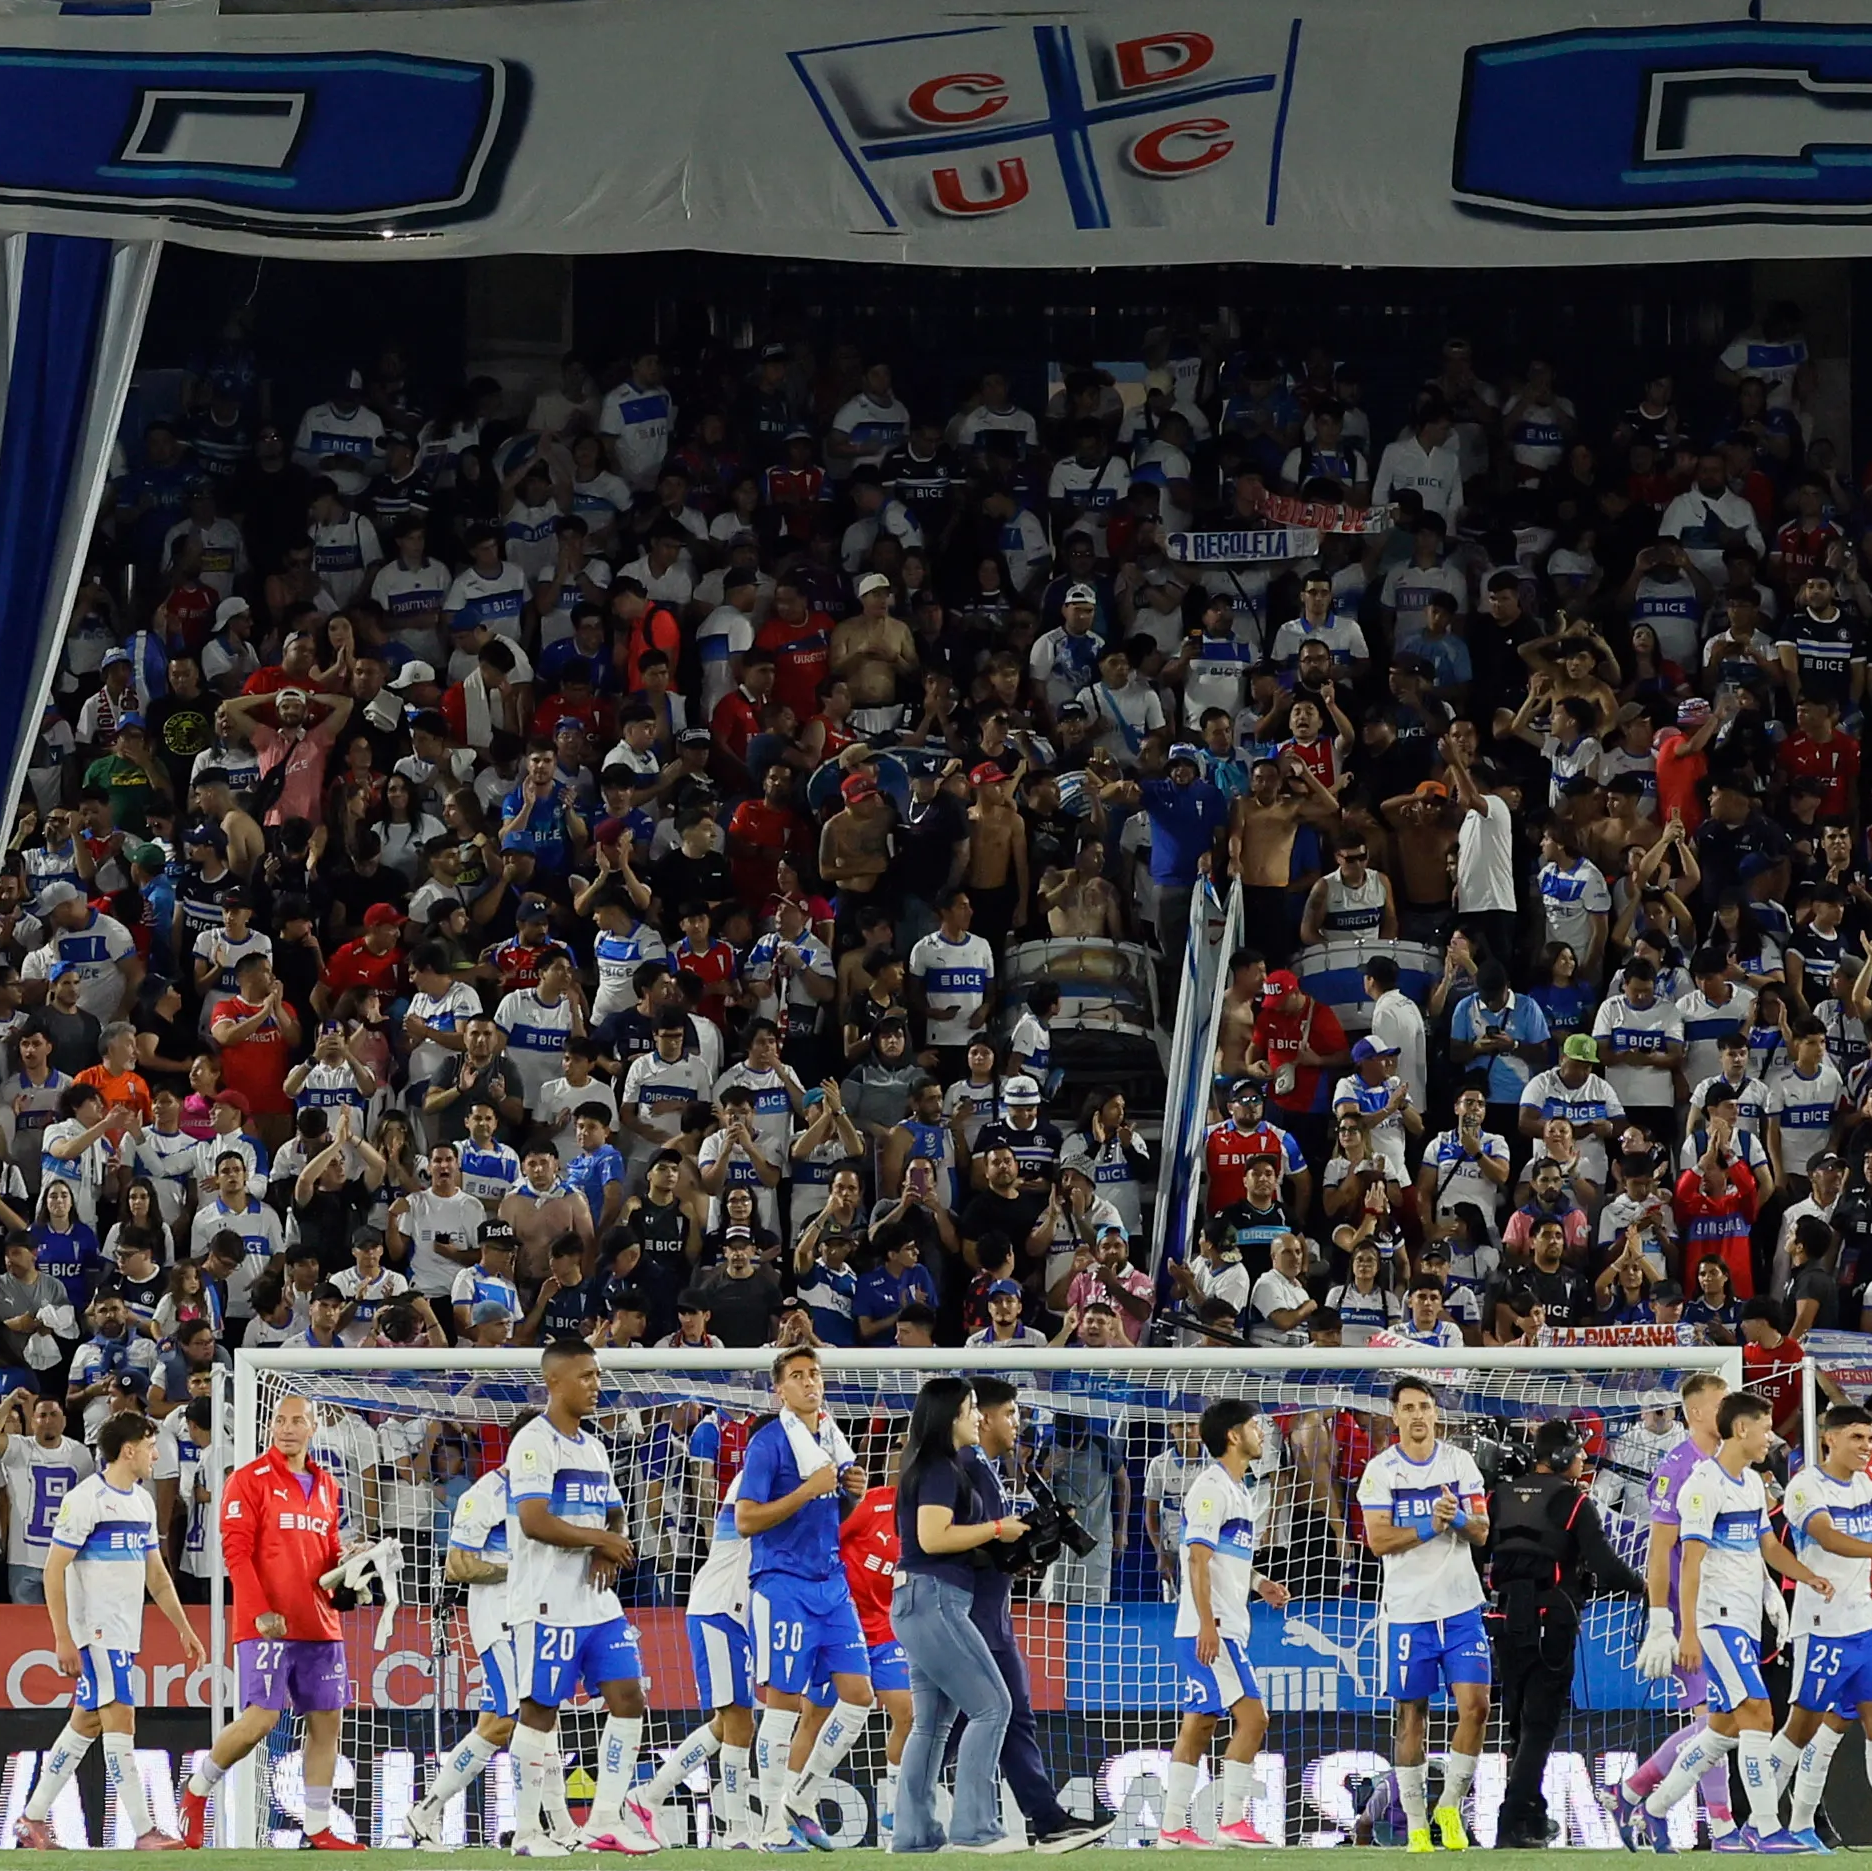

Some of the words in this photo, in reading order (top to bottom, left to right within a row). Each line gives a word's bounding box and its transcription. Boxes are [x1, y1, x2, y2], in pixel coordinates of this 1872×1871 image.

[908, 72, 1010, 125] C
[1115, 31, 1215, 88] D
[931, 156, 1030, 216] U
[1132, 118, 1234, 174] C
[331, 440, 361, 452] BICE
[1193, 535, 1288, 557] RECOLETA
[1656, 603, 1686, 614] BICE
[1816, 659, 1846, 672] BICE
[1399, 727, 1425, 738] BICE
[1338, 914, 1381, 927] DIRECTV
[605, 966, 634, 977] BICE
[953, 975, 981, 985] BICE
[1629, 1036, 1660, 1046] BICE
[1629, 1037, 1662, 1049] BICE
[323, 1093, 352, 1104] BICE
[759, 1095, 787, 1107] BICE
[1566, 1107, 1597, 1118] BICE
[1802, 1111, 1830, 1123] BICE
[1098, 1168, 1130, 1180] BICE
[50, 1263, 80, 1276] BICE
[52, 1263, 81, 1276] BICE
[1350, 1314, 1381, 1322] DIRECTV
[1584, 1326, 1678, 1346] PINTANA
[298, 1514, 329, 1534] BICE
[774, 1622, 804, 1650] 30
[540, 1628, 576, 1661] 20
[1397, 1634, 1411, 1661] 9
[256, 1642, 284, 1670] 27
[1809, 1644, 1841, 1676] 25
[607, 1734, 625, 1775] 1XBET
[680, 1743, 708, 1771] 1XBET
[1680, 1745, 1706, 1773] 1XBET
[725, 1761, 738, 1794] 1XBET
[1745, 1755, 1763, 1788] 1XBET
